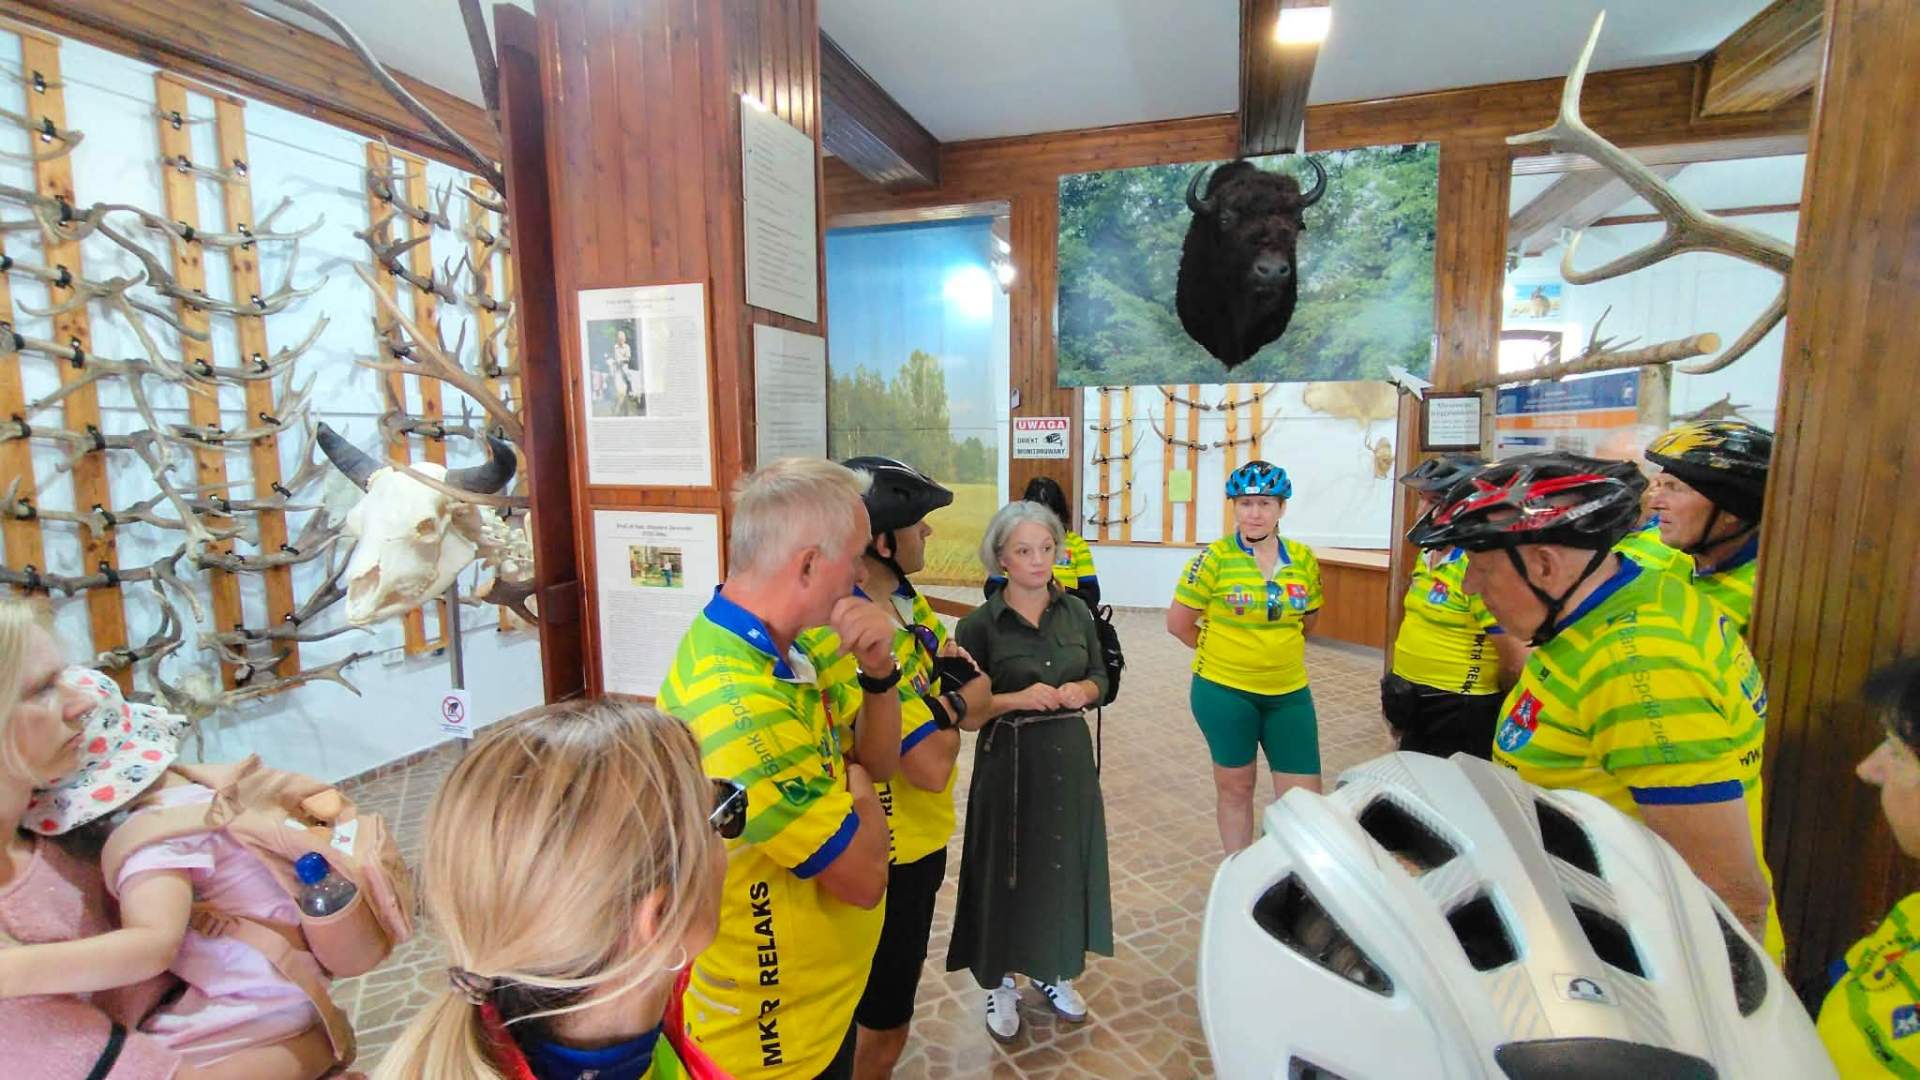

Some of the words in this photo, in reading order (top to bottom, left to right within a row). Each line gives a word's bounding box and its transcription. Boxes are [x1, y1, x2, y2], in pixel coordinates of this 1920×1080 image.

[1018, 420, 1065, 430] UWAGA
[749, 880, 780, 987] RELAKS
[758, 998, 783, 1068] MKR
